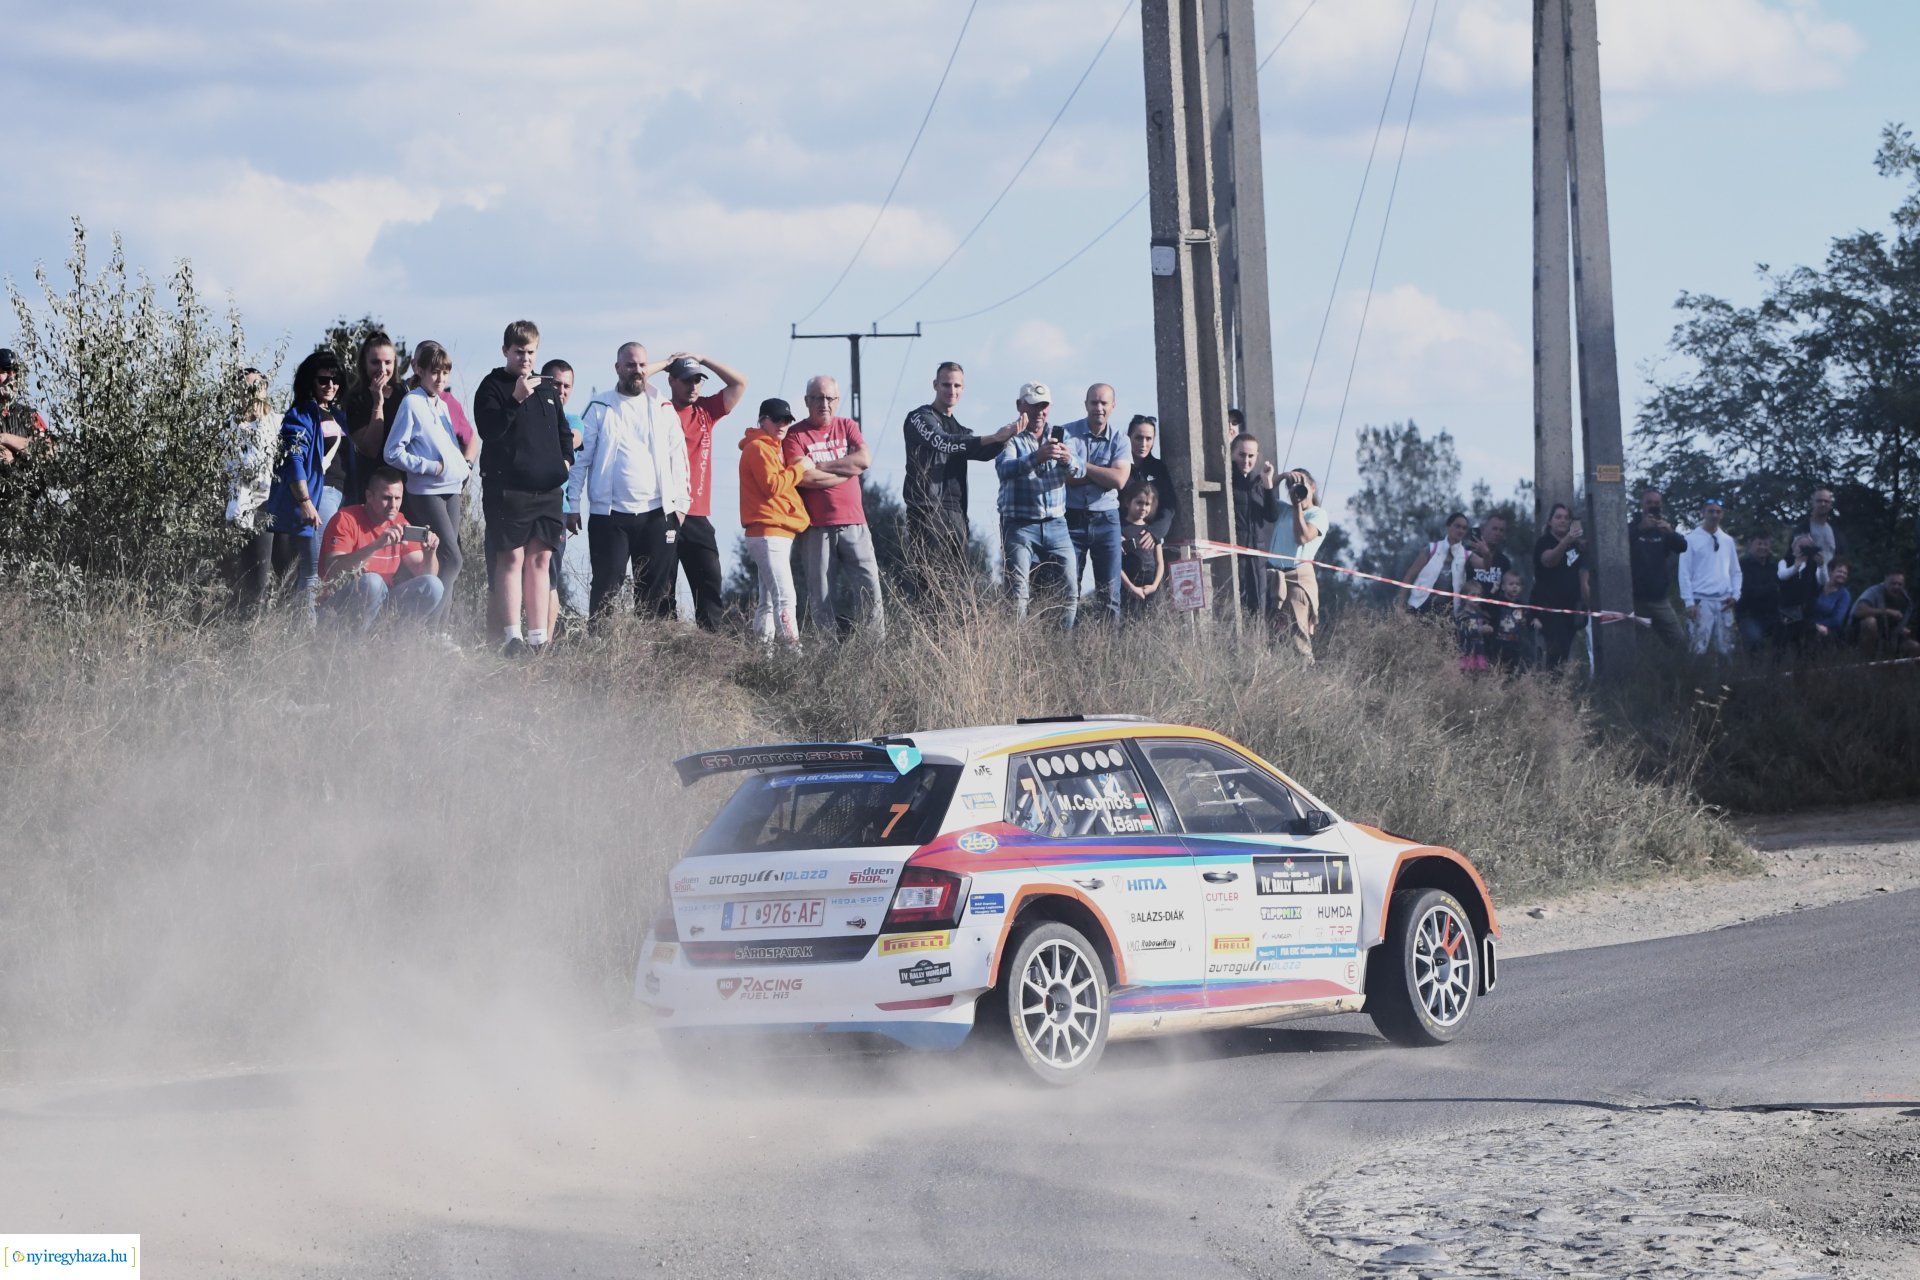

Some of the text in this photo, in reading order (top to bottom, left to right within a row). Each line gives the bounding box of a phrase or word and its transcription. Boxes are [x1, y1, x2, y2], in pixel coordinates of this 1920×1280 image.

[911, 412, 967, 453] United States
[738, 751, 864, 766] MOTORSPORT
[820, 773, 864, 781] Championship
[973, 765, 992, 777] MTE
[880, 803, 911, 839] 7
[863, 867, 894, 876] duen
[1332, 860, 1344, 890] 7
[762, 902, 822, 924] 976-AF
[1317, 905, 1353, 919] HUMDA
[1329, 925, 1353, 936] TRP
[884, 935, 944, 952] PIRELLI
[1214, 937, 1250, 950] PIRELLI
[735, 946, 813, 960] SÁROSPATAK
[909, 971, 925, 980] RALLY
[925, 966, 950, 978] HUNGARY
[1348, 964, 1356, 978] E
[743, 977, 803, 991] RACING
[740, 992, 769, 1000] FUEL
